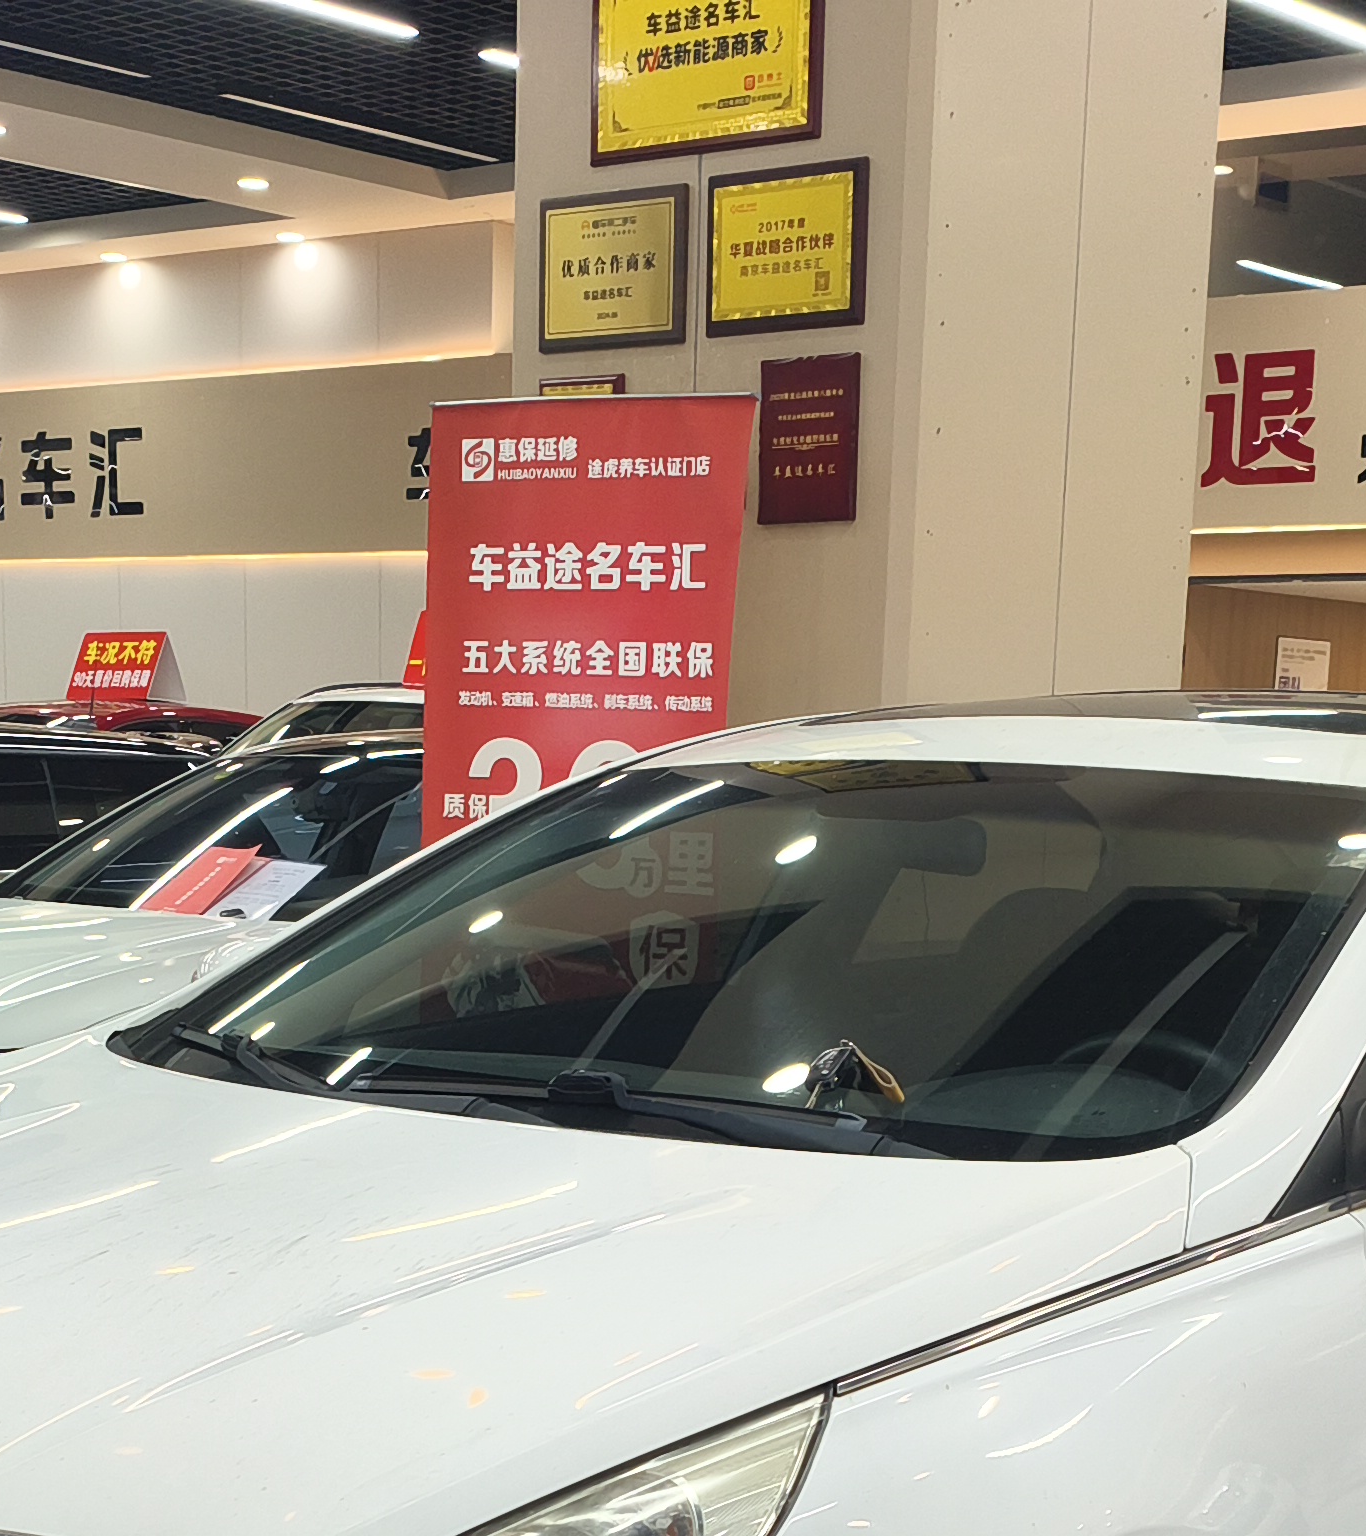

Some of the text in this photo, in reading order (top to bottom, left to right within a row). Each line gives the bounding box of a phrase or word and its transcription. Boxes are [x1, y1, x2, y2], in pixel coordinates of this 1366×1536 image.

[645, 0, 761, 37] 车益途名车汇
[636, 28, 769, 74] 优选新能源商家
[729, 232, 835, 259] 华夏战略合作伙伴
[561, 250, 657, 279] 优质合作商家
[497, 435, 579, 463] 惠保延修
[497, 466, 578, 481] HUIBAOYANXIU
[587, 455, 712, 480] 途虎养车认证门店
[468, 541, 707, 592] 车益途名车汇
[84, 640, 158, 665] 车况不符
[461, 639, 714, 679] 五大系统全国联保
